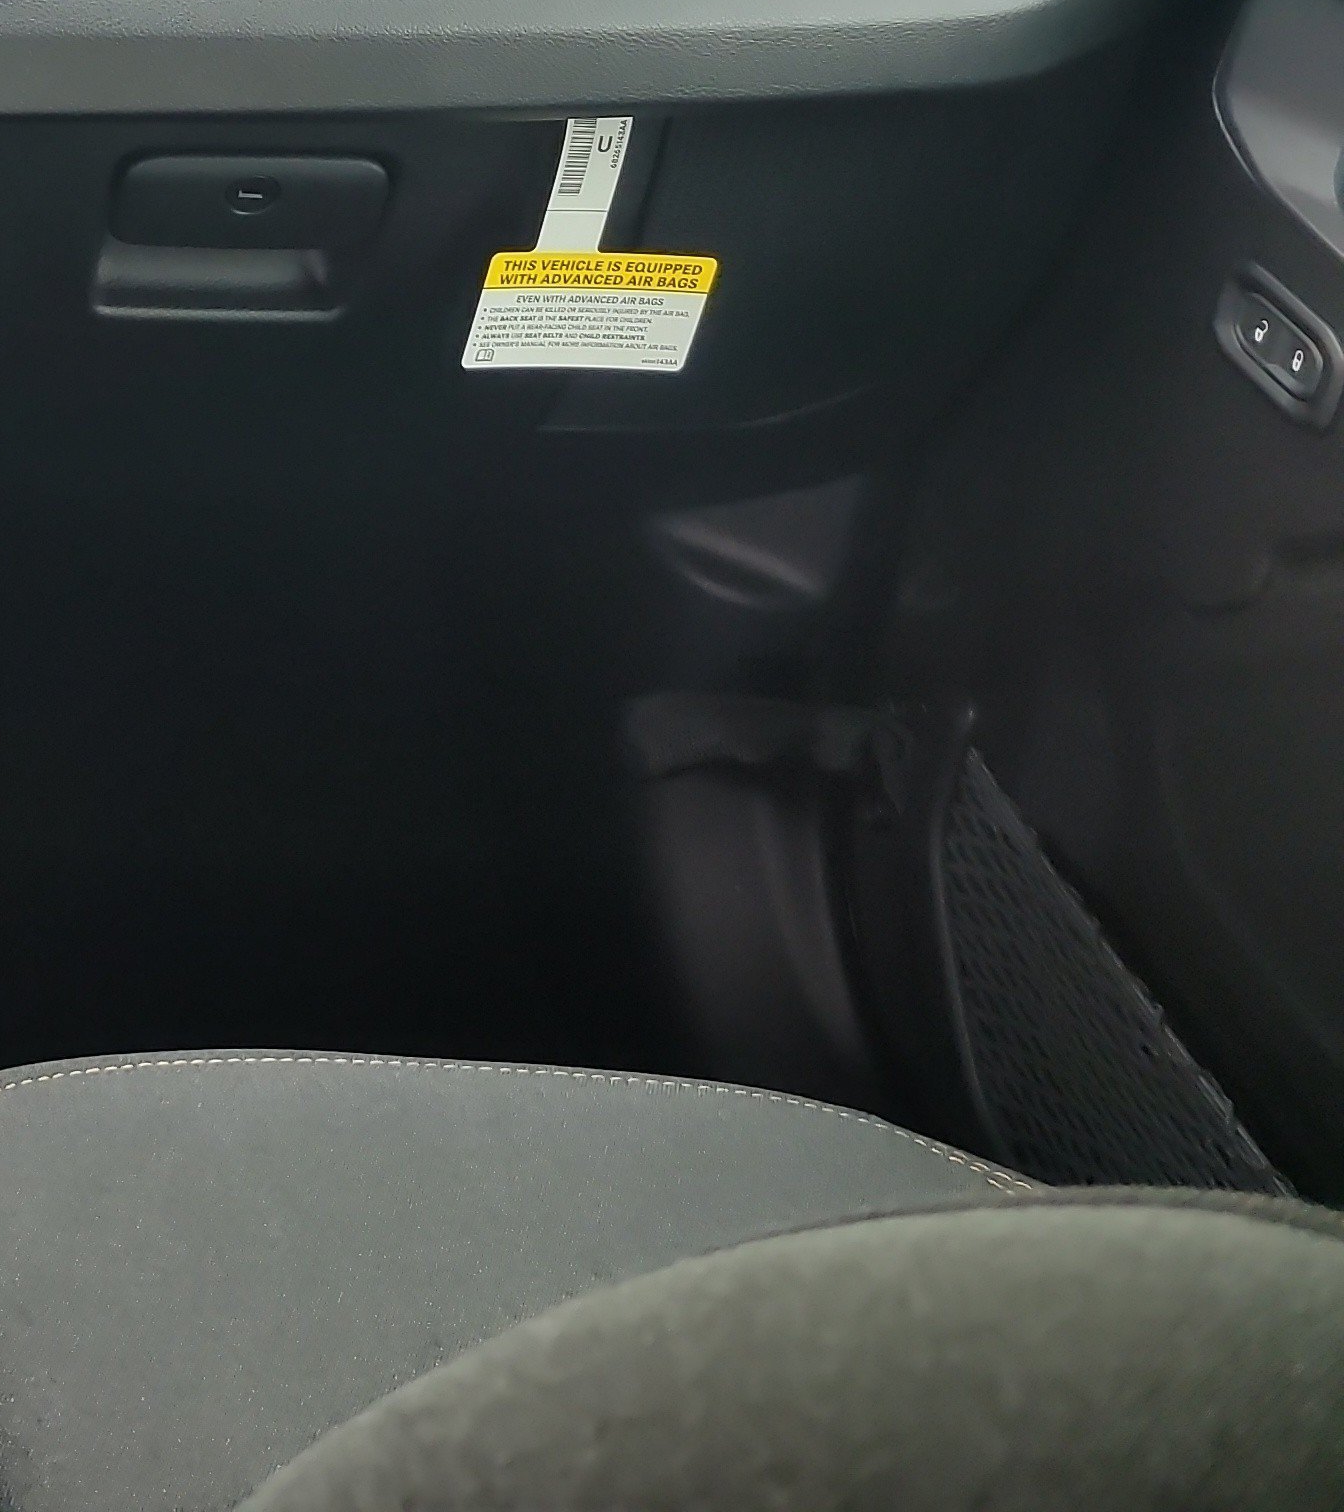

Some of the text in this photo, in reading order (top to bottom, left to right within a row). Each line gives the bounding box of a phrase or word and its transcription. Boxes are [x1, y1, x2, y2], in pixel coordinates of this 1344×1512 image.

[598, 135, 613, 153] U
[503, 260, 703, 275] THIS VEHICLE IS EQUIPPED
[500, 273, 698, 289] WITH ADVANCED AIR BAGS
[516, 295, 665, 306] EVEN WITH ADVANCED AIR BAGS
